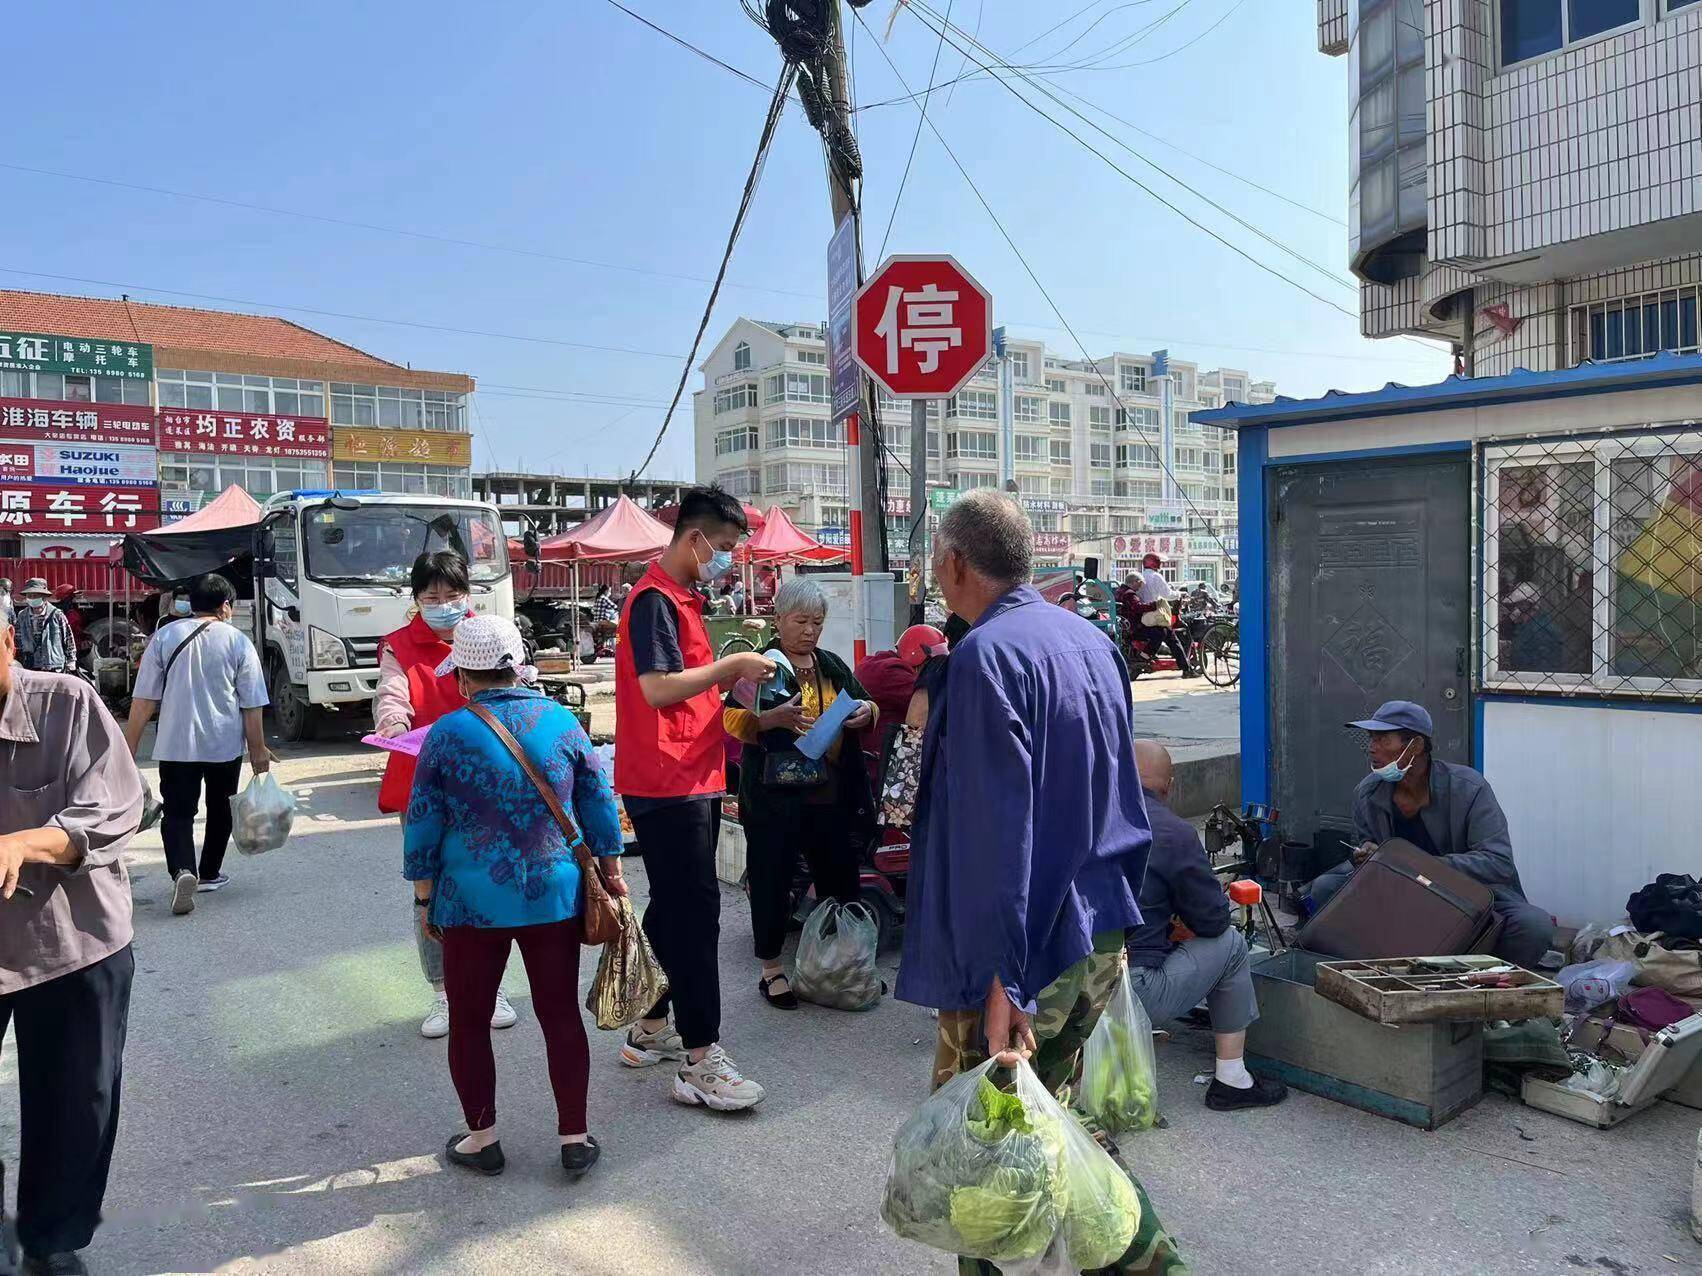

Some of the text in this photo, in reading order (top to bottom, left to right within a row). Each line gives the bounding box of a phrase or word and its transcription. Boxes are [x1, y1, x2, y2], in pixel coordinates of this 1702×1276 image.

[874, 284, 962, 374] 停
[63, 341, 138, 357] 电动三轮车
[63, 352, 138, 368] 摩托车
[2, 406, 98, 430] 淮海车辆
[103, 419, 150, 431] 三轮电动车
[196, 414, 296, 442] 均正农资
[59, 450, 120, 462] SUZUKI
[60, 465, 120, 476] Haojue
[0, 490, 142, 527] 源车行
